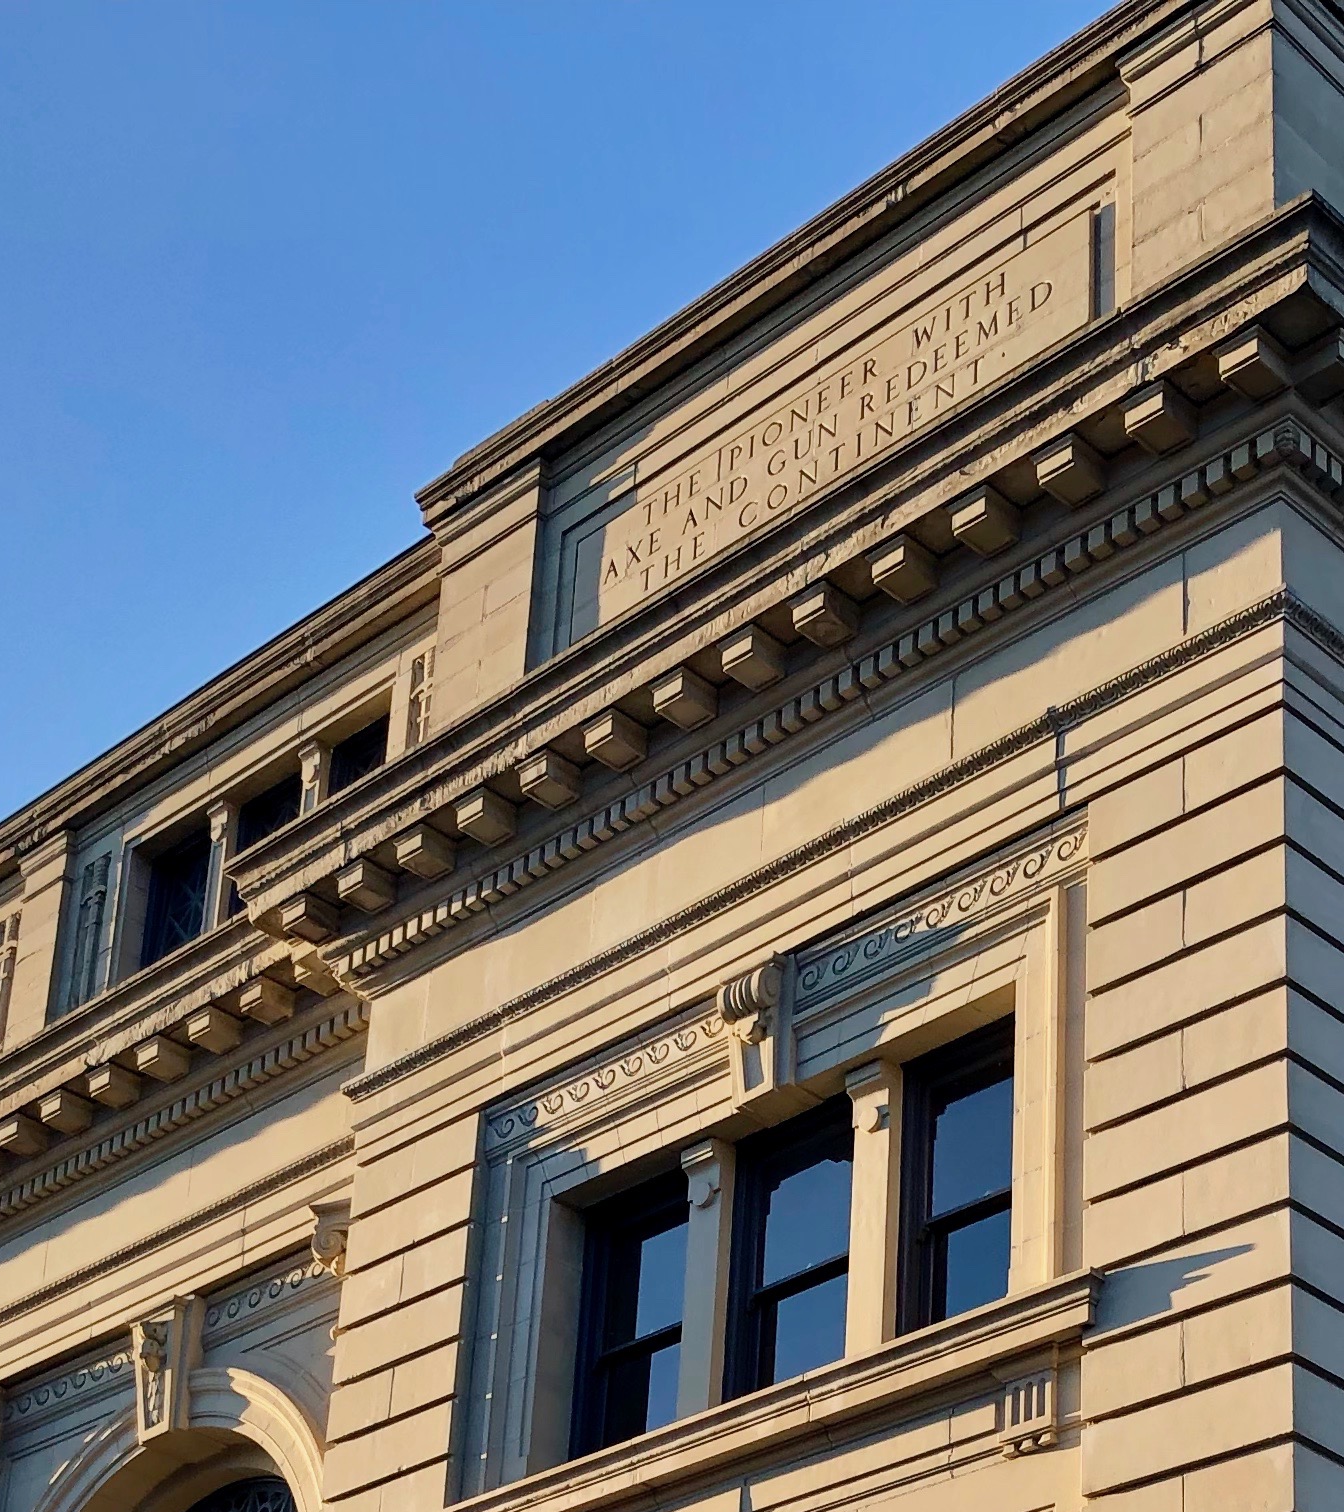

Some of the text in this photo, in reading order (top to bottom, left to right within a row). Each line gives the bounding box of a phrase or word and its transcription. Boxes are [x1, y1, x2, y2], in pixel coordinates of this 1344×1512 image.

[604, 280, 1053, 585] AXE AND GUN REDEEMED
[642, 271, 1006, 526] THE PIONEER WITH
[640, 531, 705, 592] THE
